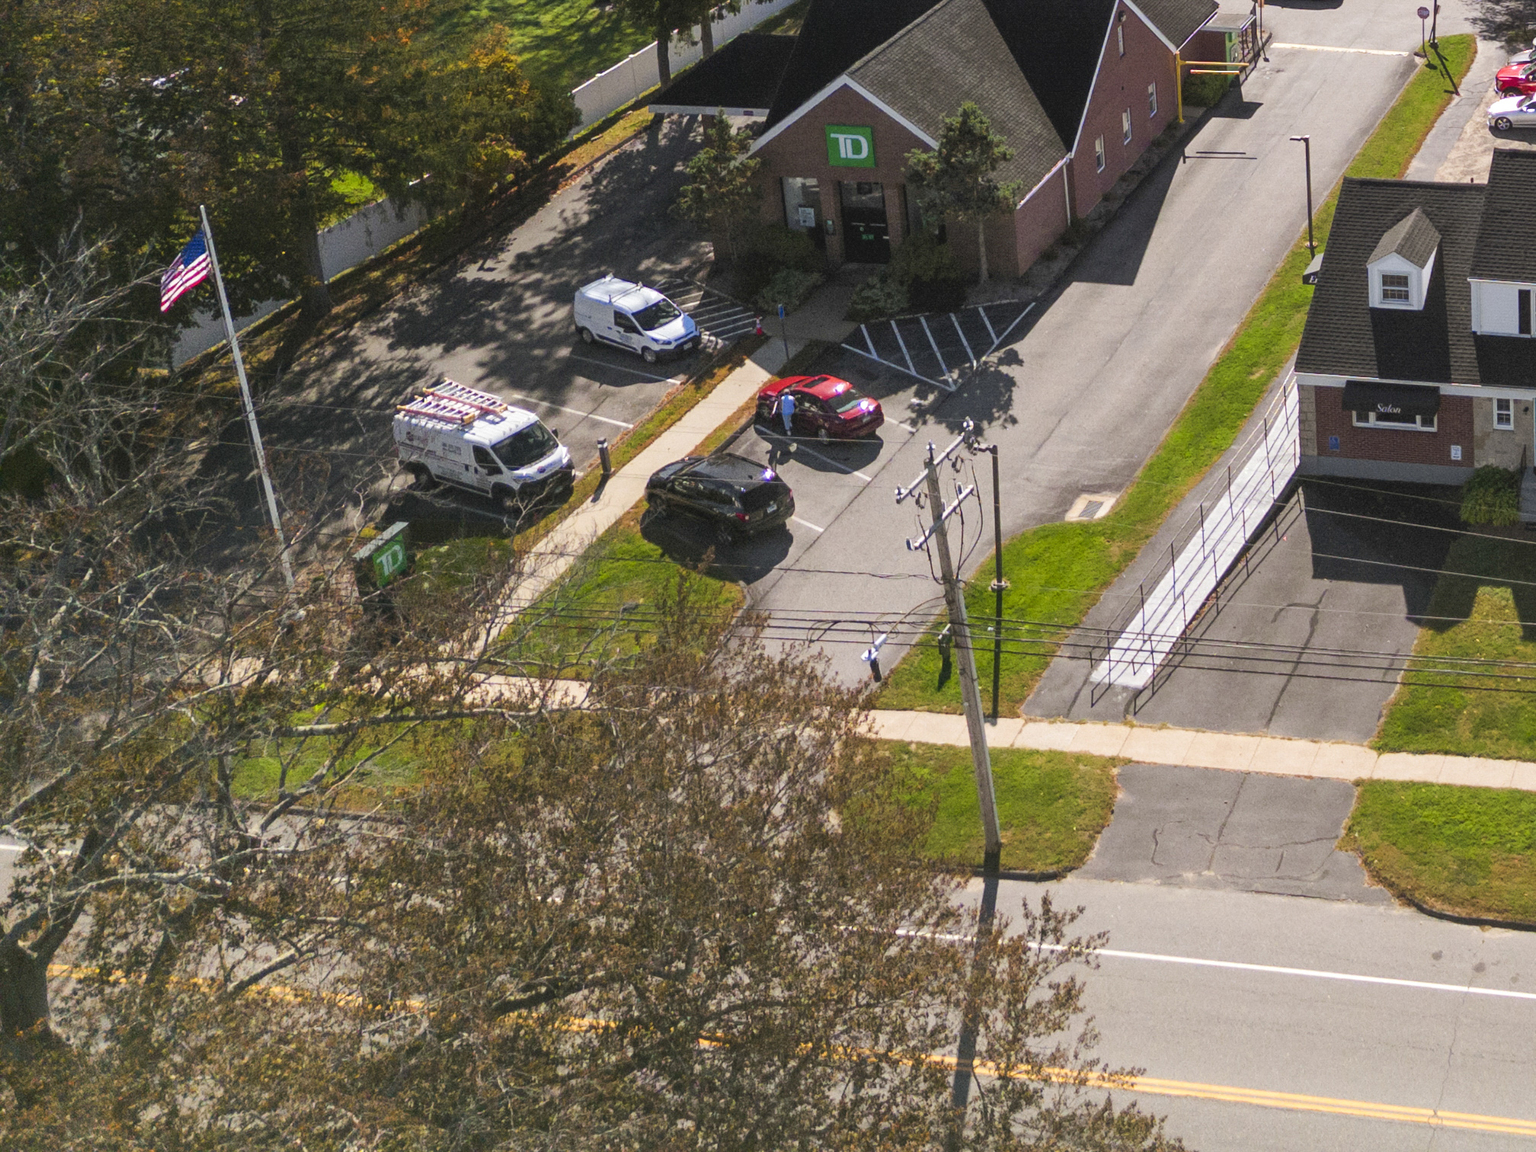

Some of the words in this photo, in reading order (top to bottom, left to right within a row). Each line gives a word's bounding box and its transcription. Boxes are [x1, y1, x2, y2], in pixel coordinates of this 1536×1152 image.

[830, 133, 868, 159] TD
[1376, 403, 1401, 413] Salon
[376, 545, 403, 576] TD
